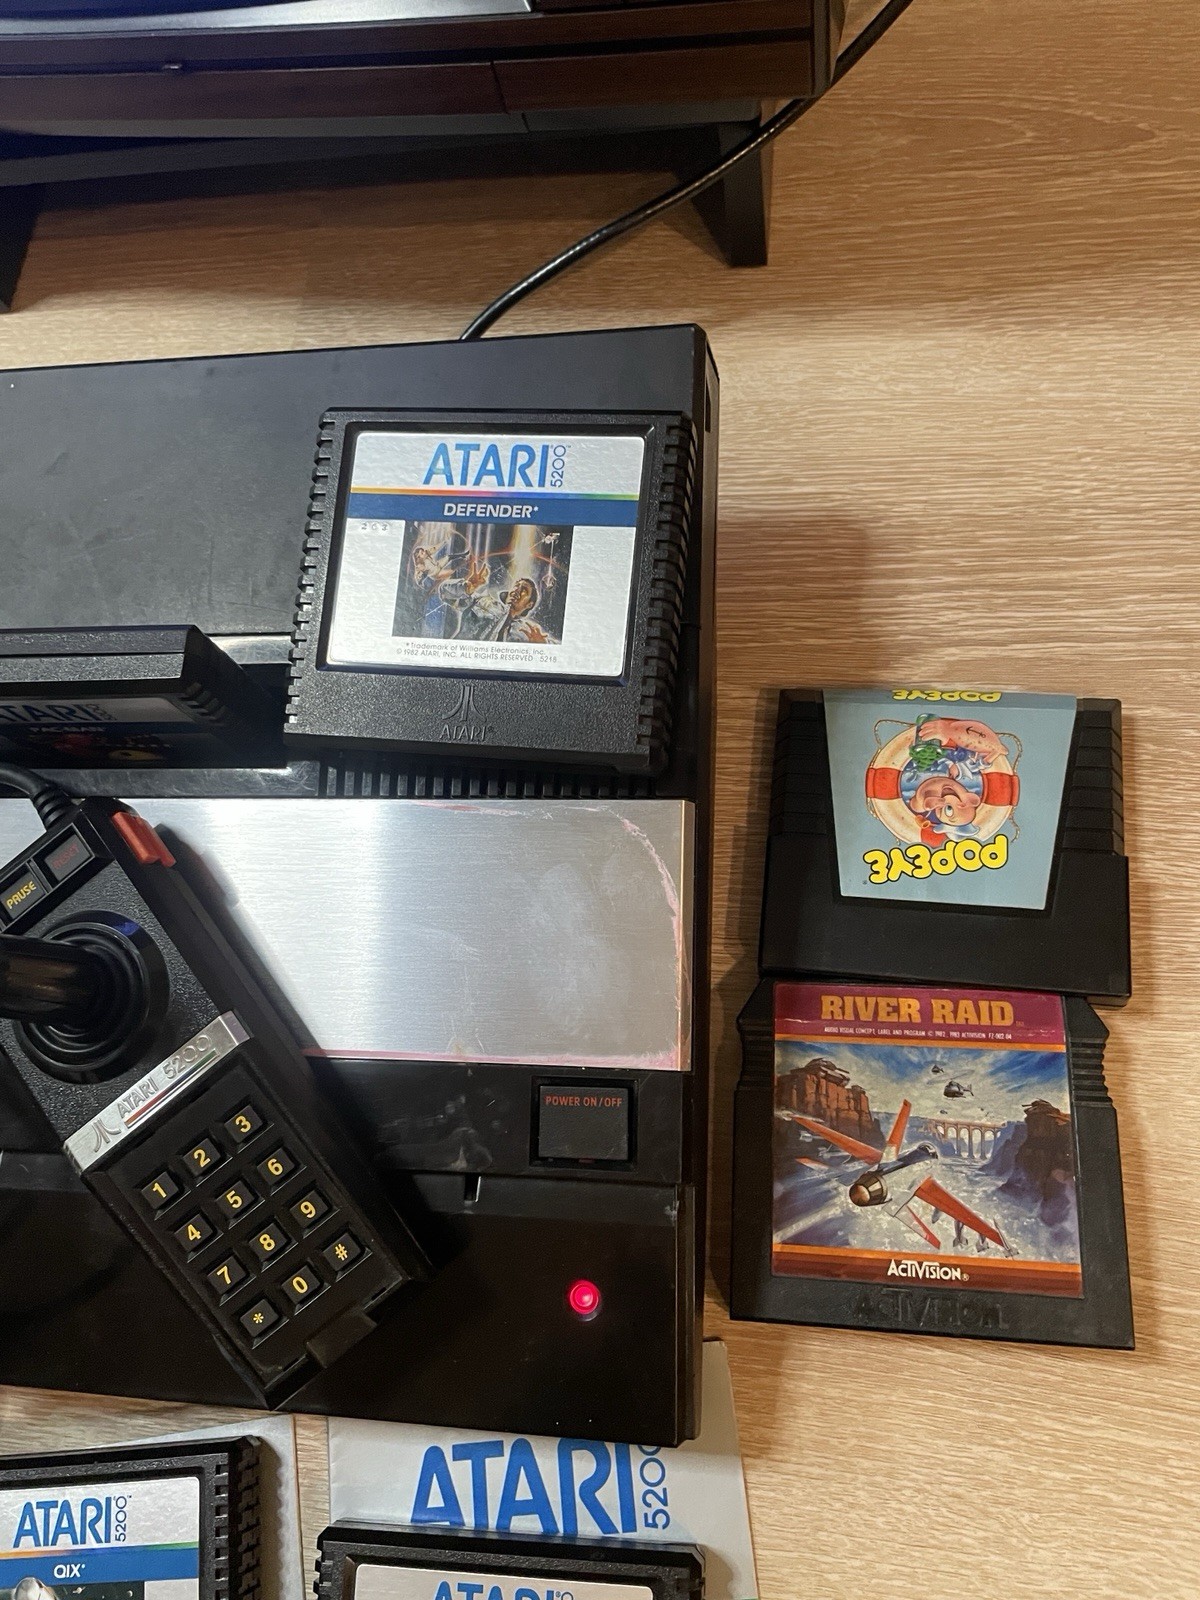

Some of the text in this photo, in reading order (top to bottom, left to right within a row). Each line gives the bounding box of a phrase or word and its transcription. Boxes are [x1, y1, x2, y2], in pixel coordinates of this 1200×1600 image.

[422, 443, 549, 488] ATARI
[551, 445, 567, 488] 5200
[460, 645, 489, 653] Williams
[474, 653, 498, 661] RIGHTS
[500, 654, 534, 662] RESERVED
[891, 689, 1002, 703] POPEYE
[440, 724, 487, 741] ATARI
[863, 834, 1008, 884] POPEYE
[6, 880, 37, 909] PAUSE
[821, 995, 1014, 1027] RIVER RAID
[116, 1034, 212, 1119] ATARI 5200
[545, 1096, 580, 1107] POWER
[153, 1115, 251, 1198] 1 2 3
[187, 1158, 283, 1242] 4 5 6
[216, 1200, 316, 1285] 7 8 9
[292, 1276, 308, 1294] 0
[334, 1243, 348, 1261] #
[411, 1437, 638, 1536] ATARI
[13, 1496, 112, 1548] ATARI
[114, 1495, 127, 1543] 5200
